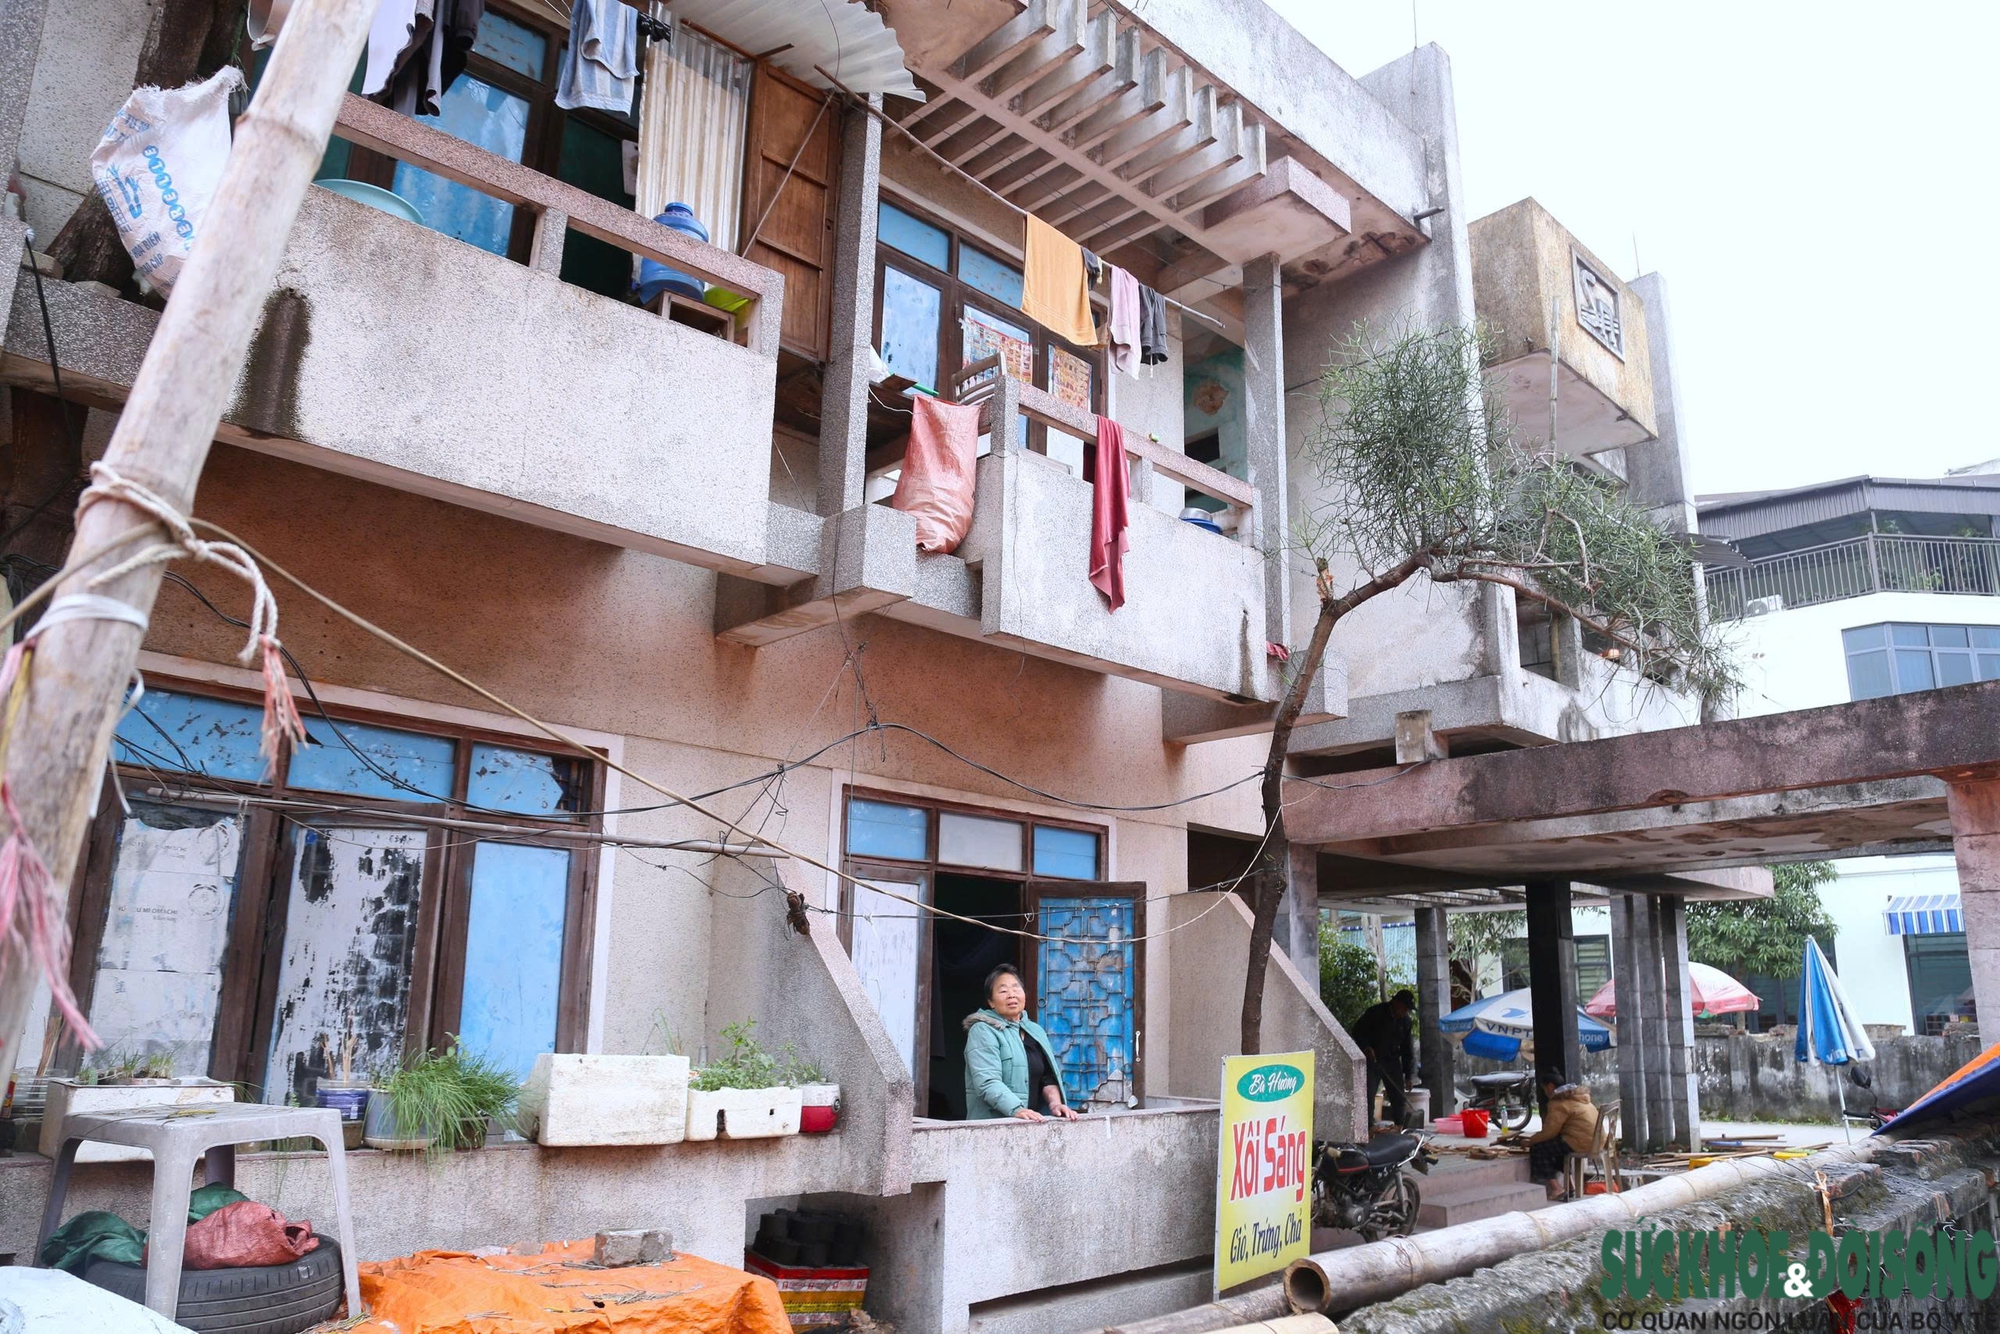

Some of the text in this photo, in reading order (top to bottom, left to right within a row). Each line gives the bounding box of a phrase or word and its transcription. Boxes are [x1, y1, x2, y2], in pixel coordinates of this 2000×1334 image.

[1486, 1022, 1532, 1038] VNPT
[1249, 1074, 1266, 1095] Bà
[1230, 1115, 1306, 1203] Xôi Sáng
[1230, 1207, 1303, 1264] Giò, Trứng, Chả
